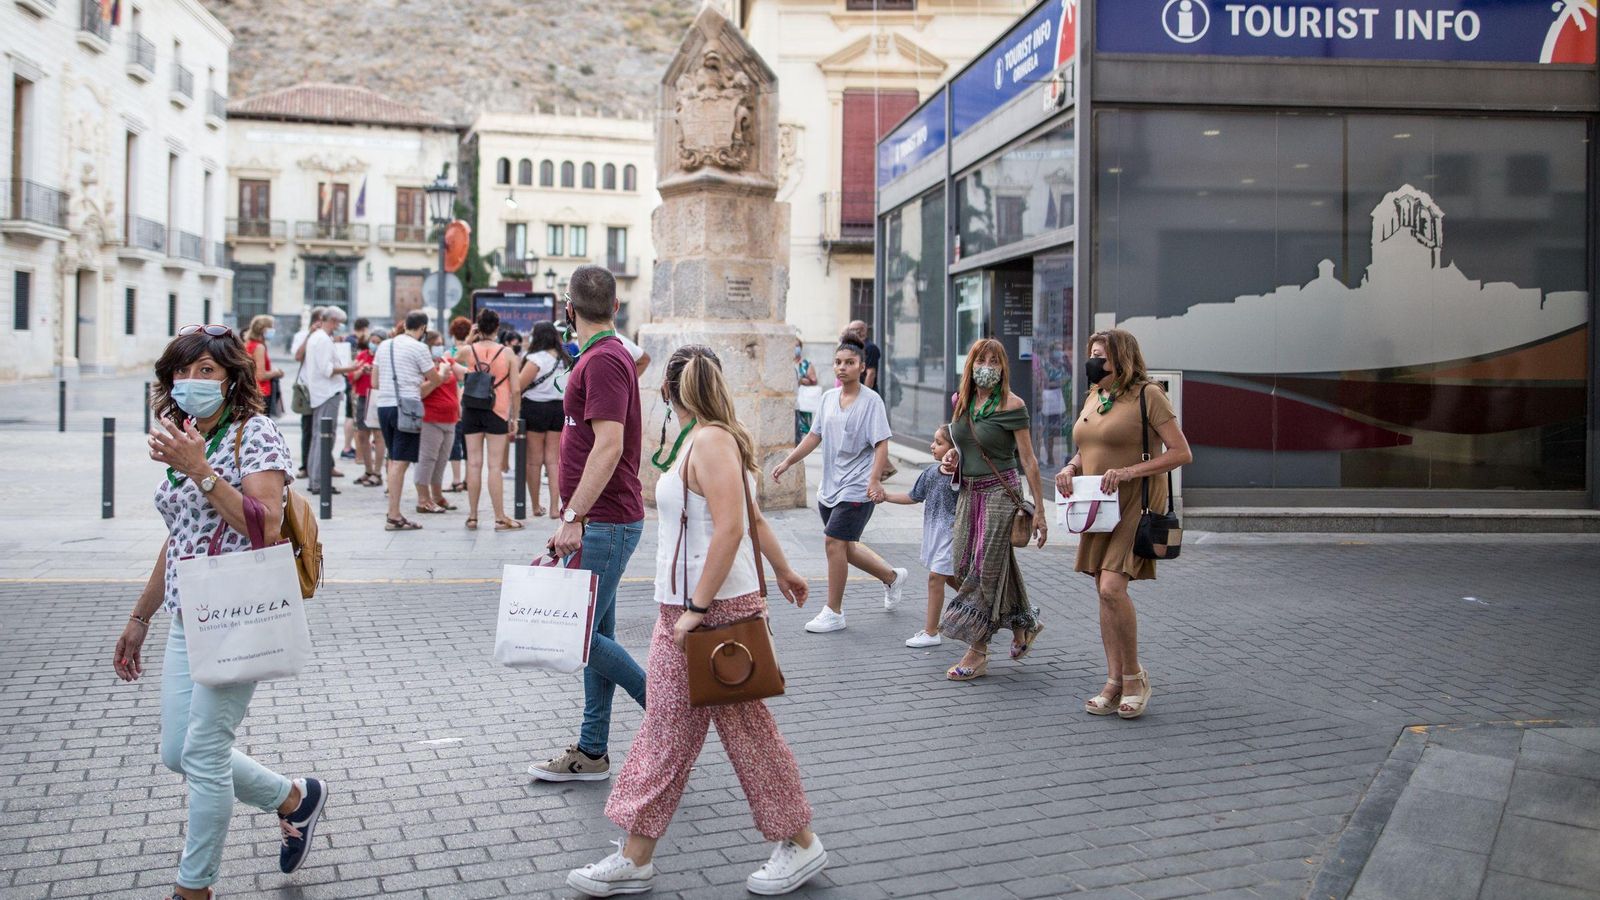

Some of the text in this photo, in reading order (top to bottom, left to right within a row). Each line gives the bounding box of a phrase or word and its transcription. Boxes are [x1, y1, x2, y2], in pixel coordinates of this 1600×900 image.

[1225, 4, 1481, 42] TOURIST INFO
[1005, 19, 1051, 71] TOURIST INFO
[197, 599, 290, 623] ORIHUELA
[509, 601, 579, 619] ORIHUELA
[199, 622, 228, 633] historia
